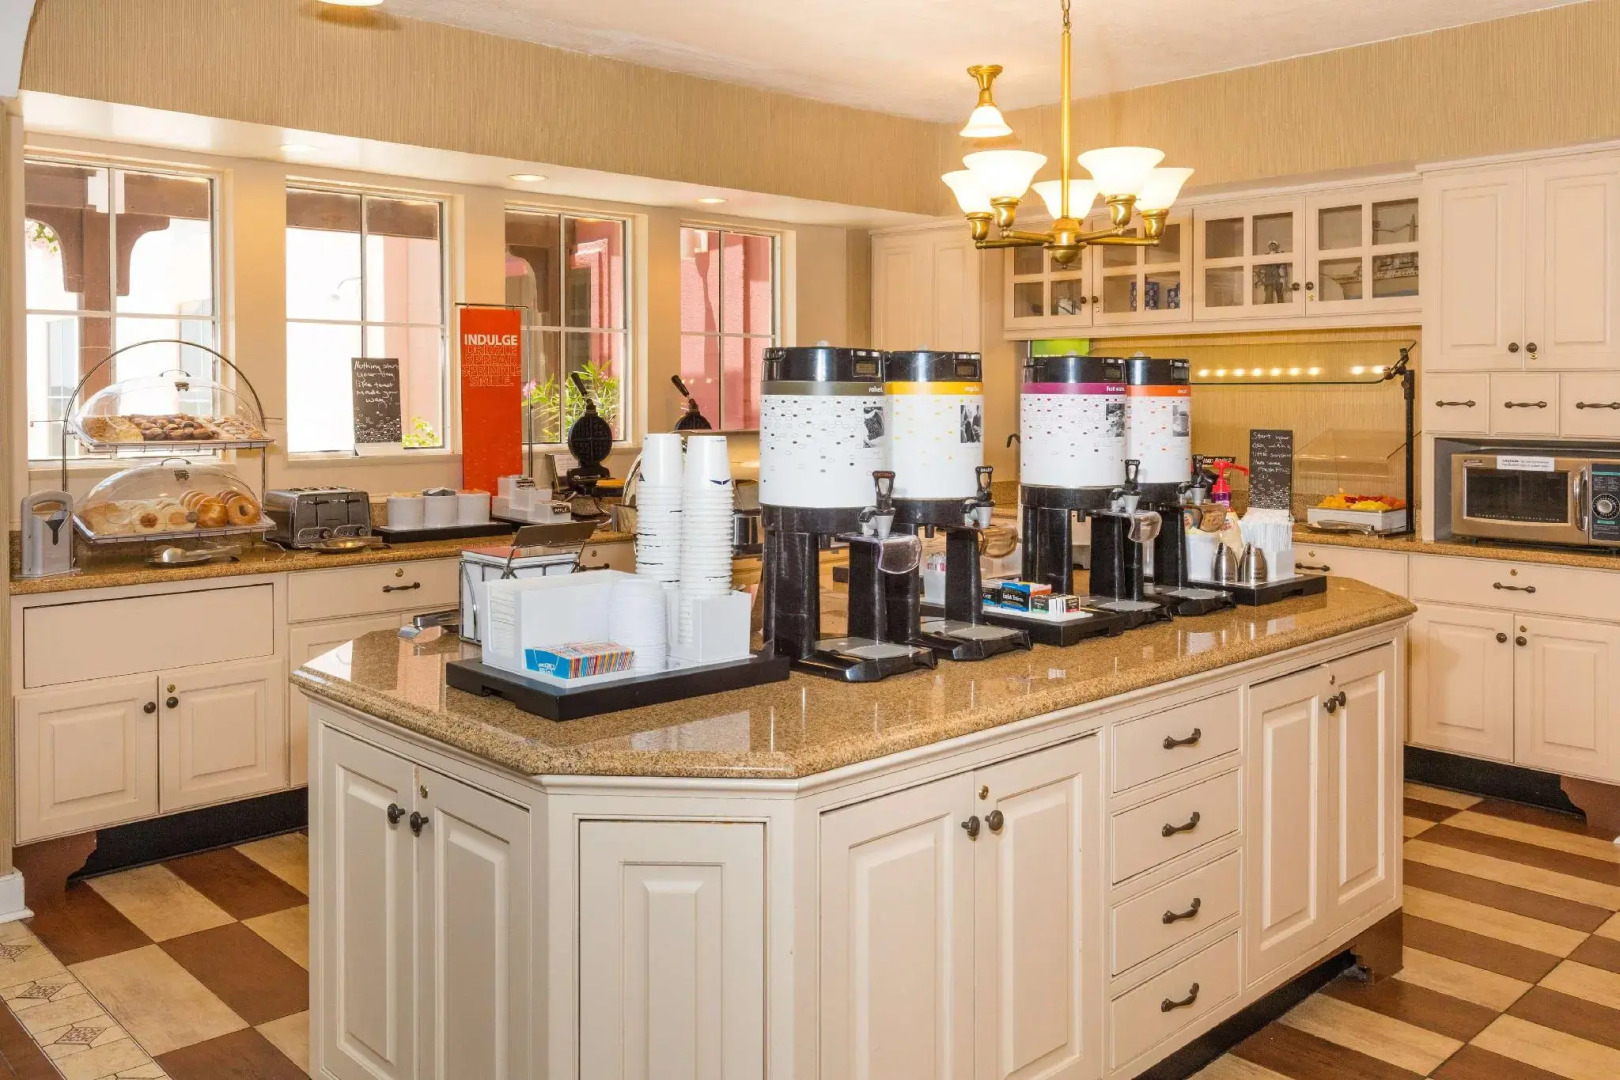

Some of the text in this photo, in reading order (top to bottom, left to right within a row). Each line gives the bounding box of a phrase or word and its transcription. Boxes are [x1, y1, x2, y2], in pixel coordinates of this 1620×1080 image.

[464, 334, 518, 346] INDULGE
[467, 345, 518, 355] DRIZZLE
[465, 354, 518, 366] SPREAD
[354, 360, 382, 373] Nothing
[462, 365, 522, 376] SPRINKLE
[469, 375, 515, 387] SMILE.
[1251, 431, 1271, 440] Start
